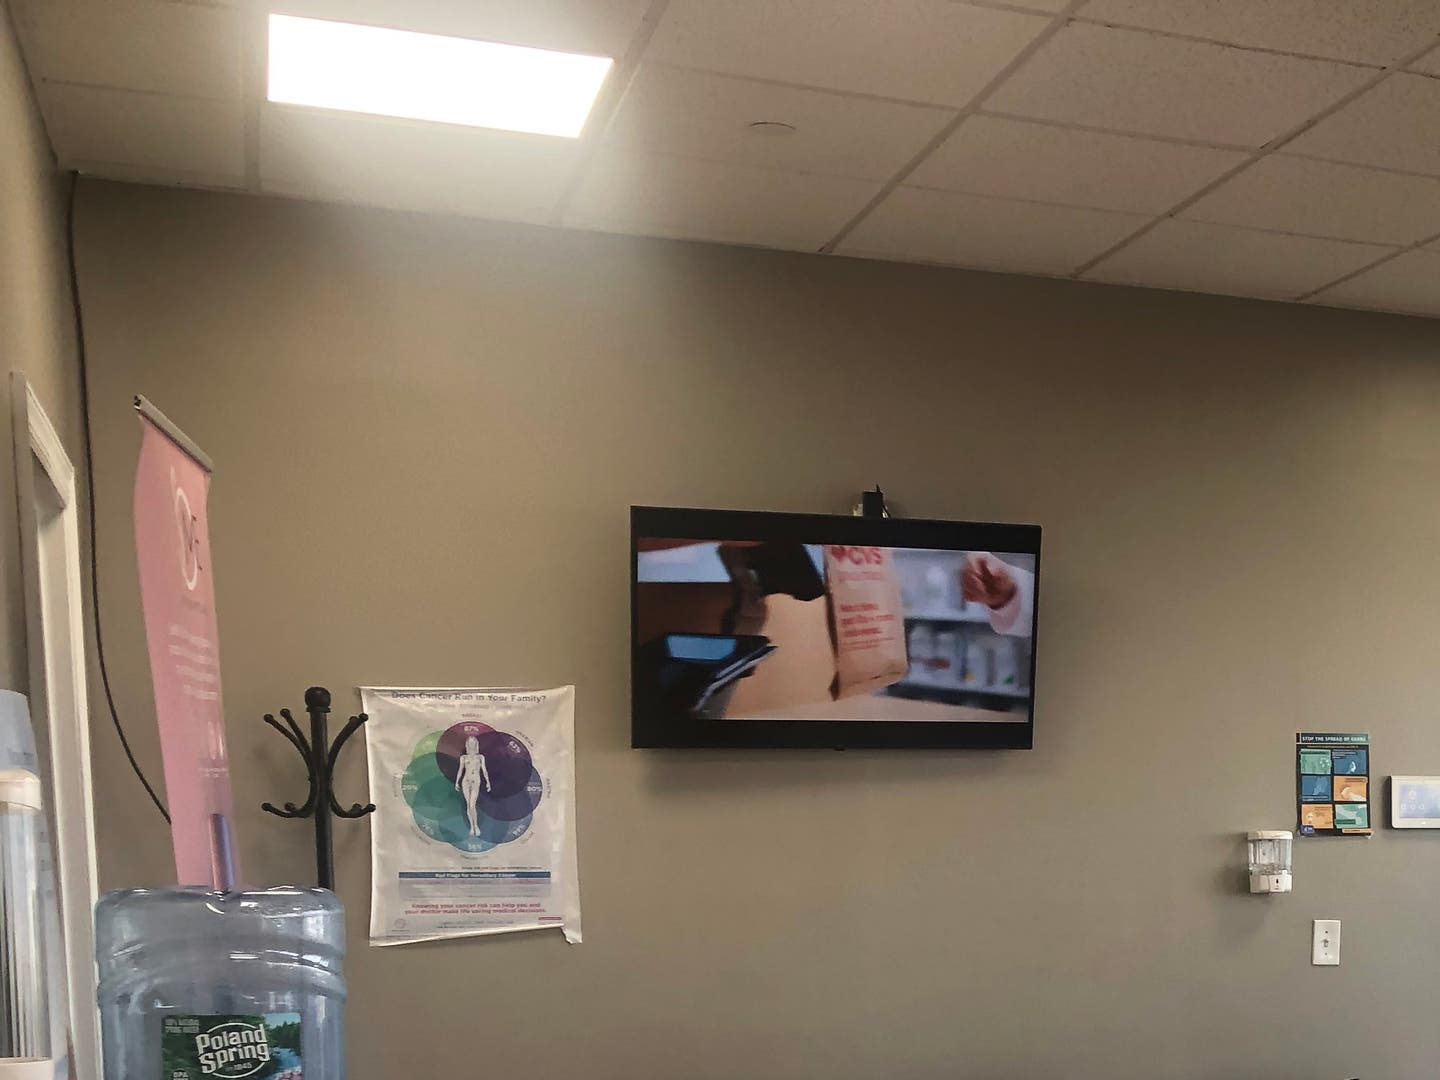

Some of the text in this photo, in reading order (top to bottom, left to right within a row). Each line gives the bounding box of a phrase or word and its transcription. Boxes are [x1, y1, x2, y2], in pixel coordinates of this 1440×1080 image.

[418, 692, 451, 700] Cancer
[488, 694, 508, 702] Your
[511, 694, 547, 704] Family?
[195, 1023, 268, 1056] Poland
[198, 1043, 270, 1074] Spring
